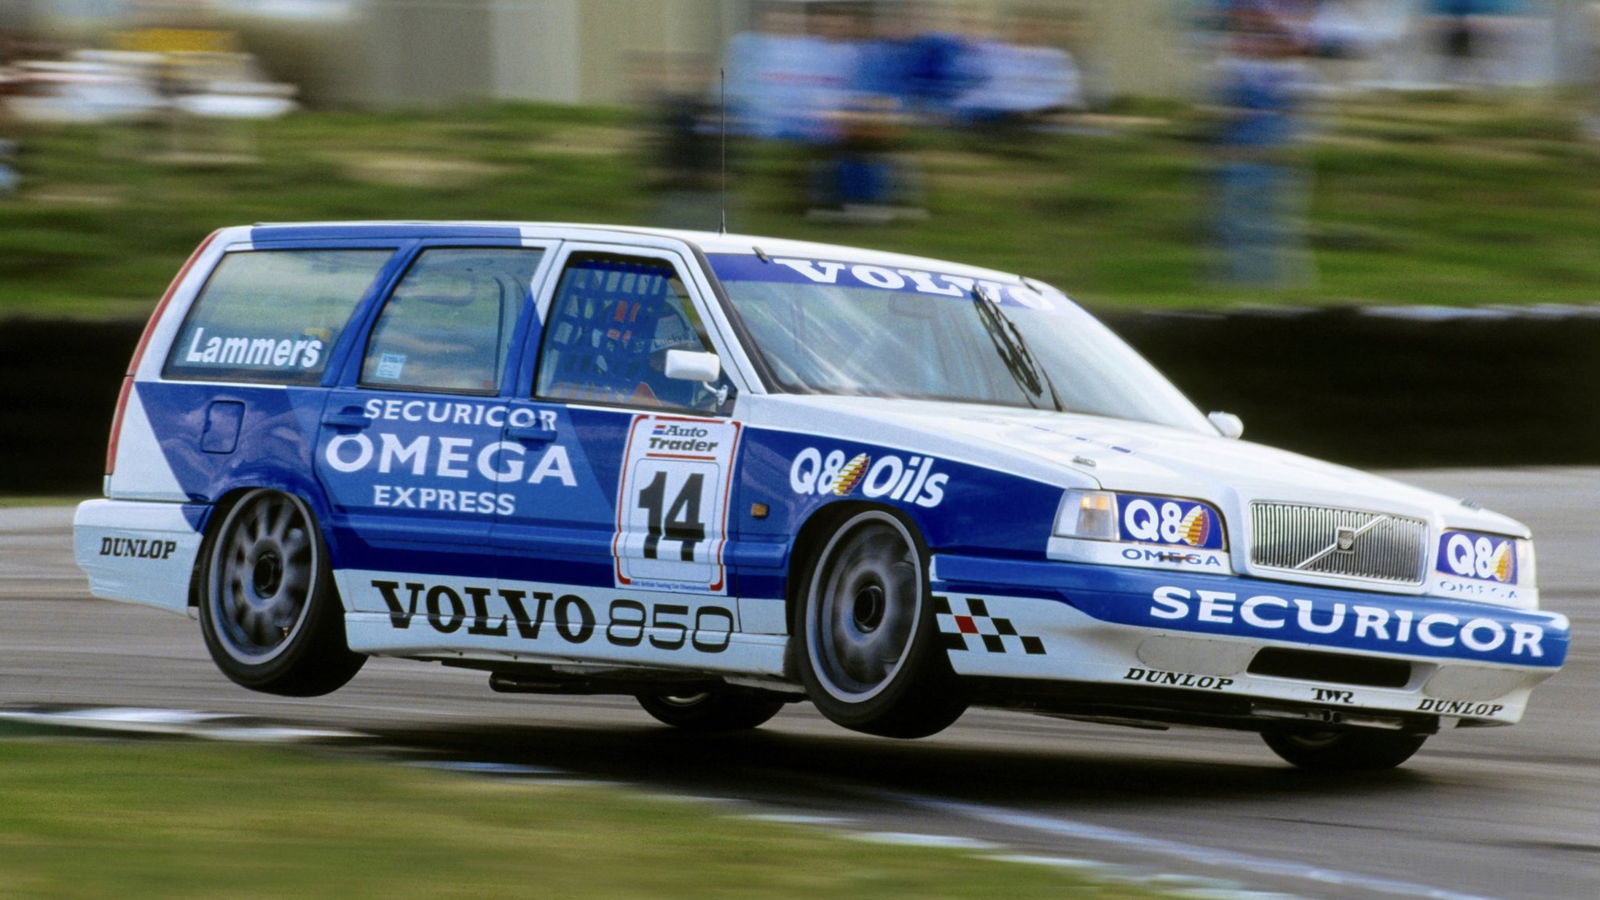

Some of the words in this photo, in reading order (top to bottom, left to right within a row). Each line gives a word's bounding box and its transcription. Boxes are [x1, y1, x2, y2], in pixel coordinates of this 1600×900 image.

[186, 327, 322, 368] Lammers
[364, 399, 557, 431] SECURICOR
[664, 425, 708, 438] Auto
[325, 433, 577, 487] OMEGA
[649, 437, 718, 452] Trader
[790, 447, 846, 495] Q8
[862, 455, 949, 508] Oils
[373, 485, 515, 516] EXPRESS
[638, 471, 705, 562] 14
[1124, 499, 1182, 543] Q8
[100, 537, 176, 560] DUNLOP
[1447, 534, 1495, 580] Q8
[371, 580, 596, 644] VOLVO
[606, 599, 733, 653] 850
[1150, 585, 1544, 658] SECURICOR
[1123, 668, 1234, 690] DUNLOP
[1312, 688, 1354, 704] TWR
[1417, 699, 1504, 716] DUNLOP
